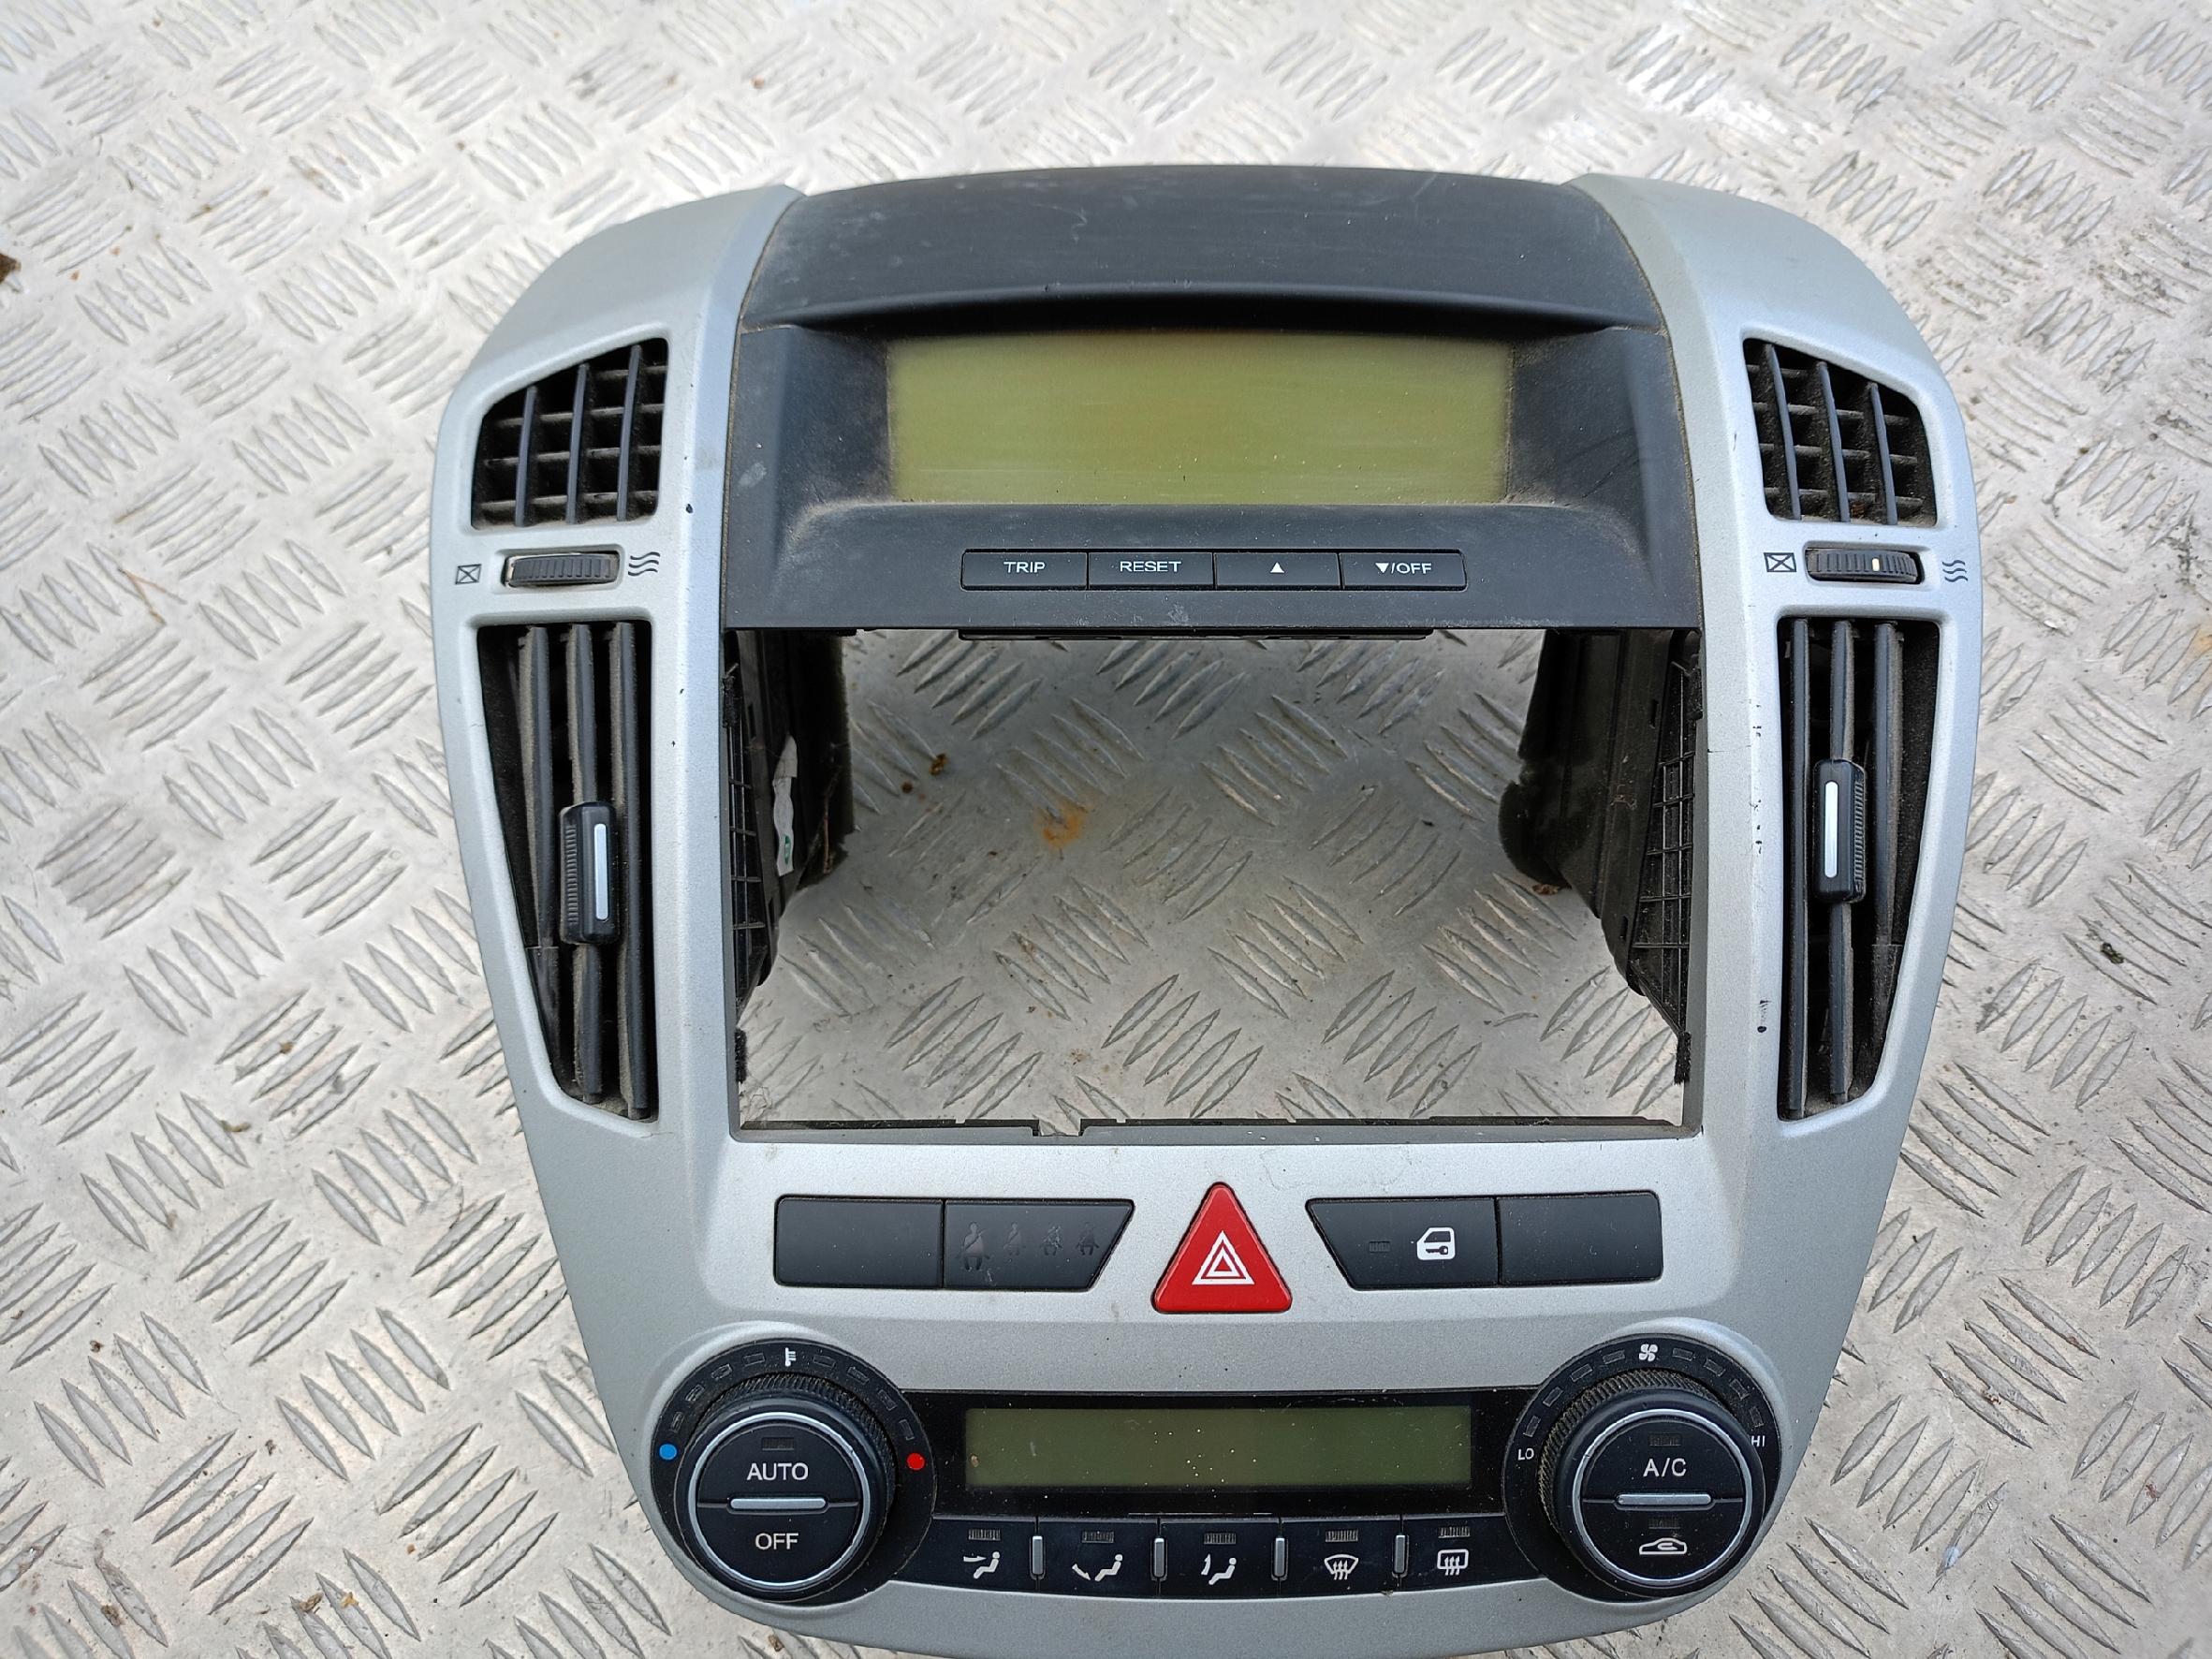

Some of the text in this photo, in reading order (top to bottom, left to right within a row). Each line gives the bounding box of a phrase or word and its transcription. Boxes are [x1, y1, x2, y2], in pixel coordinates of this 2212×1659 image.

[1003, 560, 1046, 573] TRIP
[1119, 560, 1182, 573] RESET
[1751, 1434, 1766, 1448] HI
[1517, 1447, 1535, 1461] LO
[746, 1462, 810, 1482] AUTO
[1643, 1457, 1688, 1478] A/C
[754, 1533, 799, 1551] OFF
